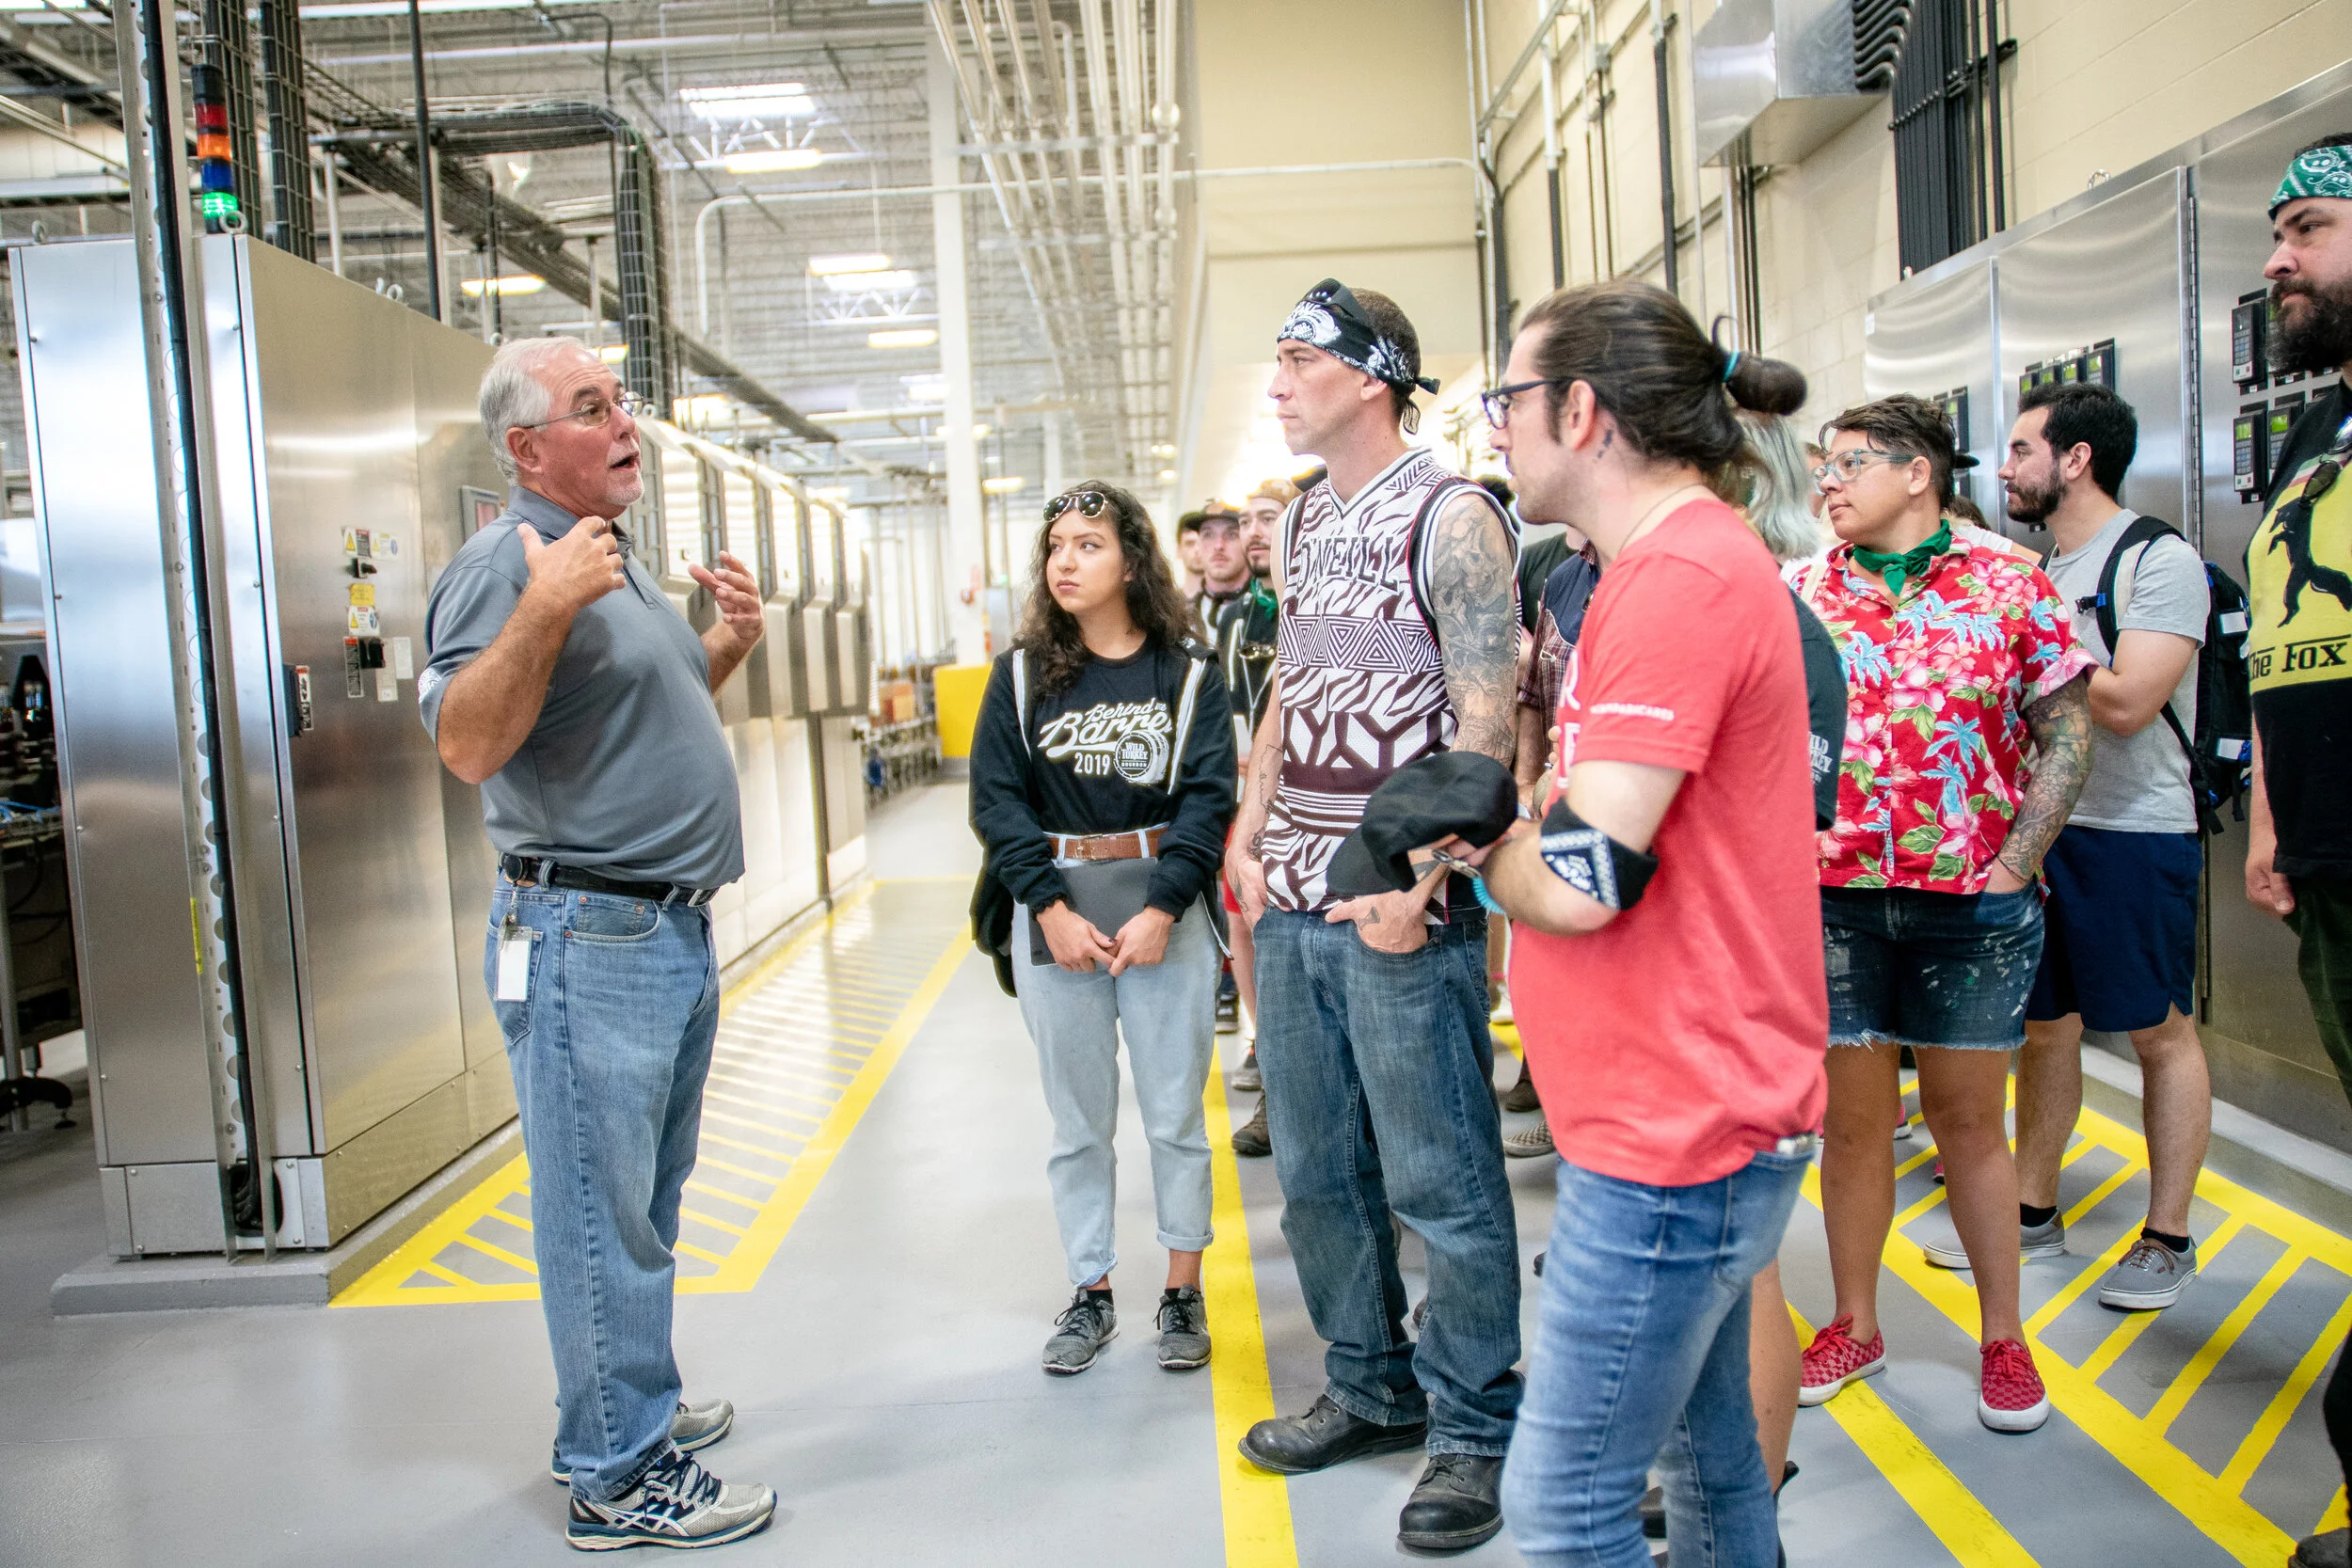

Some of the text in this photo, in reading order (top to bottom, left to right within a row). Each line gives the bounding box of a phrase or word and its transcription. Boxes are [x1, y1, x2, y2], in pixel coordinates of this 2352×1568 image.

[1082, 697, 1156, 726] Behind
[1120, 749, 1149, 760] TURKEY
[1125, 741, 1145, 752] WILD
[1809, 734, 1829, 755] ILD
[1074, 752, 1111, 776] 2019
